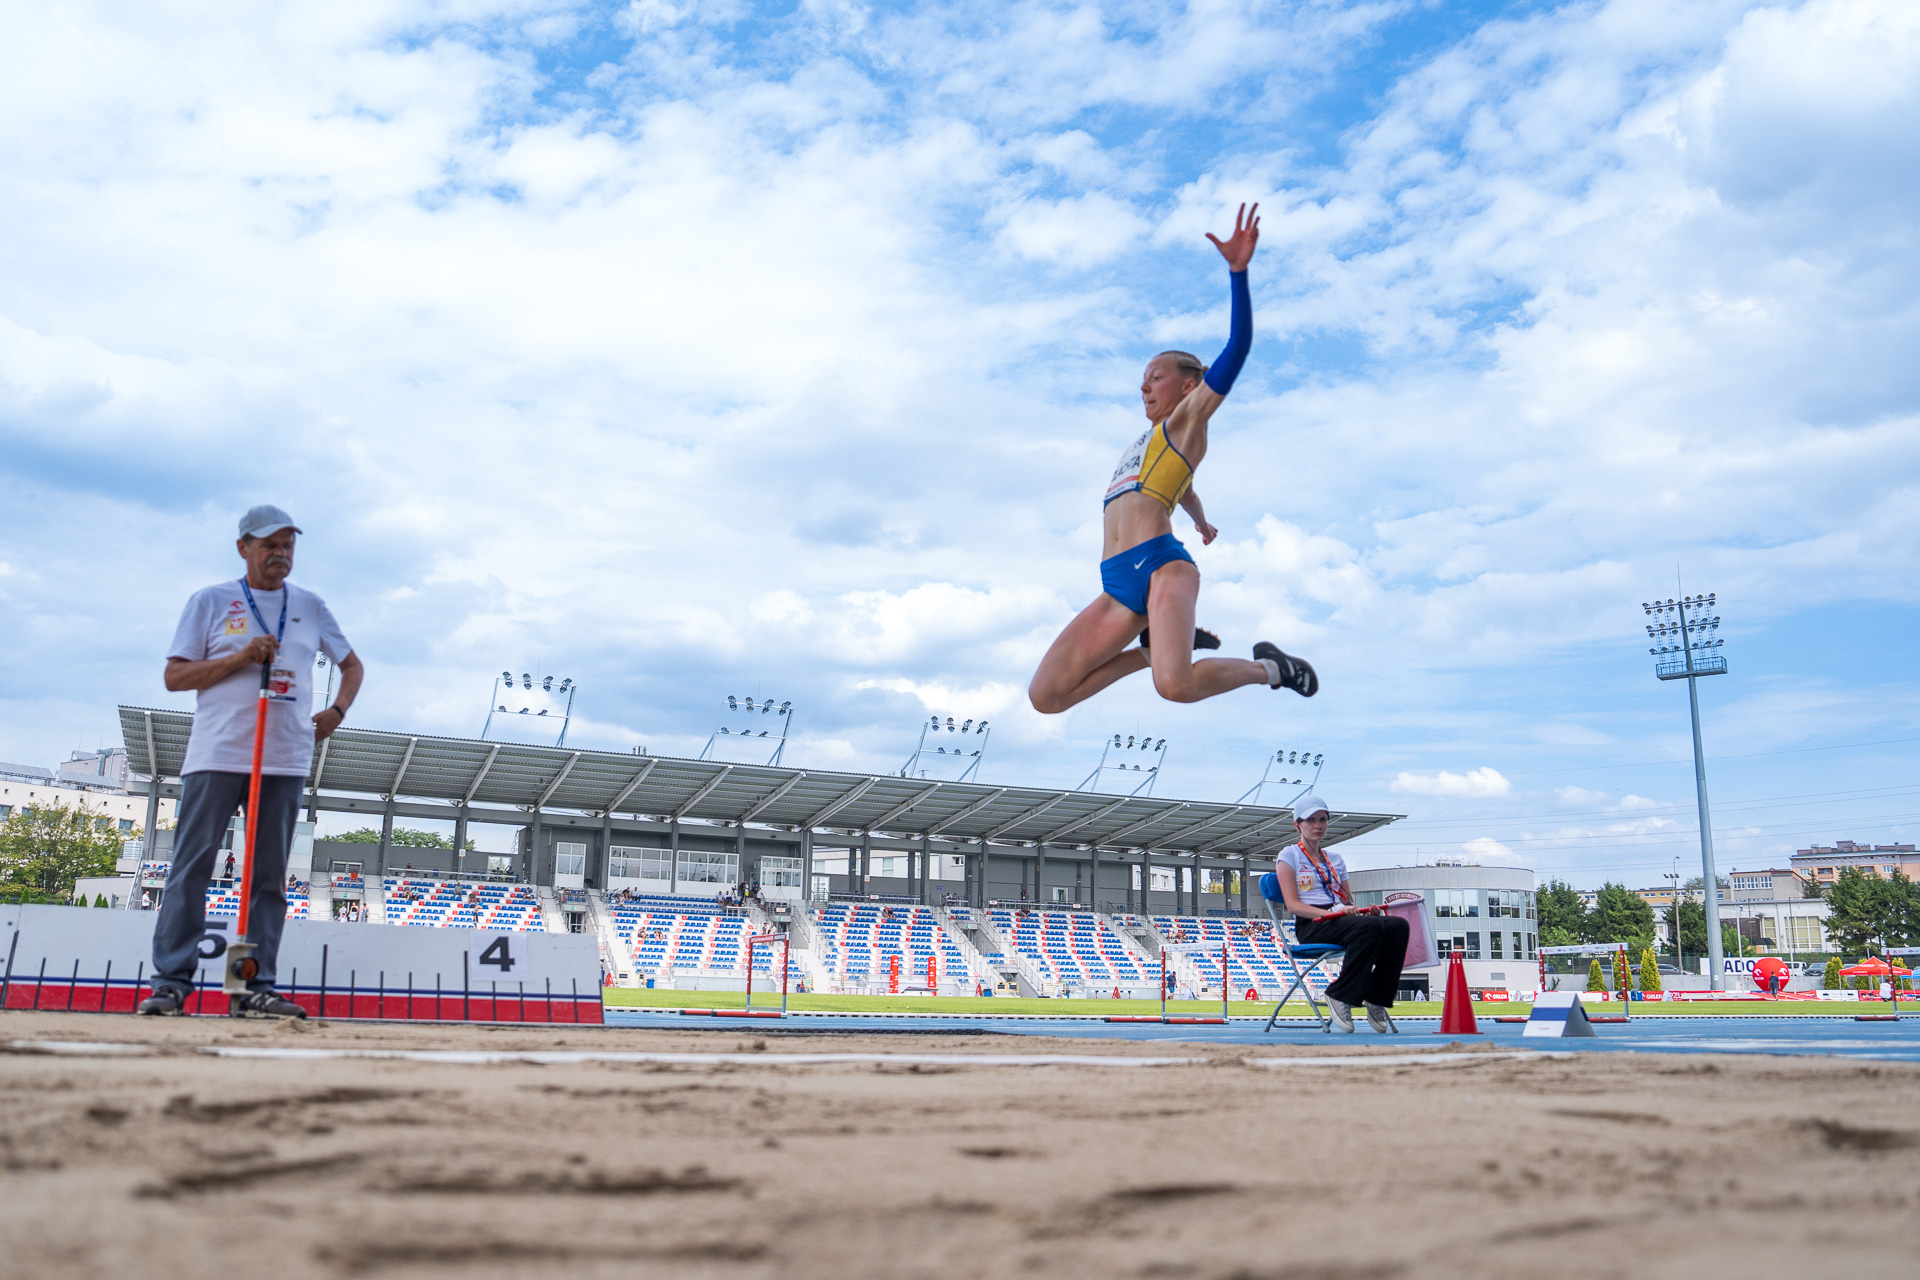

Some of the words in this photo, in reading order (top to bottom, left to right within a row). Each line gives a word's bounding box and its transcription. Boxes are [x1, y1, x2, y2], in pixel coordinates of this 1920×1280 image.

[199, 921, 228, 959] 5
[479, 936, 516, 972] 4
[1723, 960, 1755, 973] ADO
